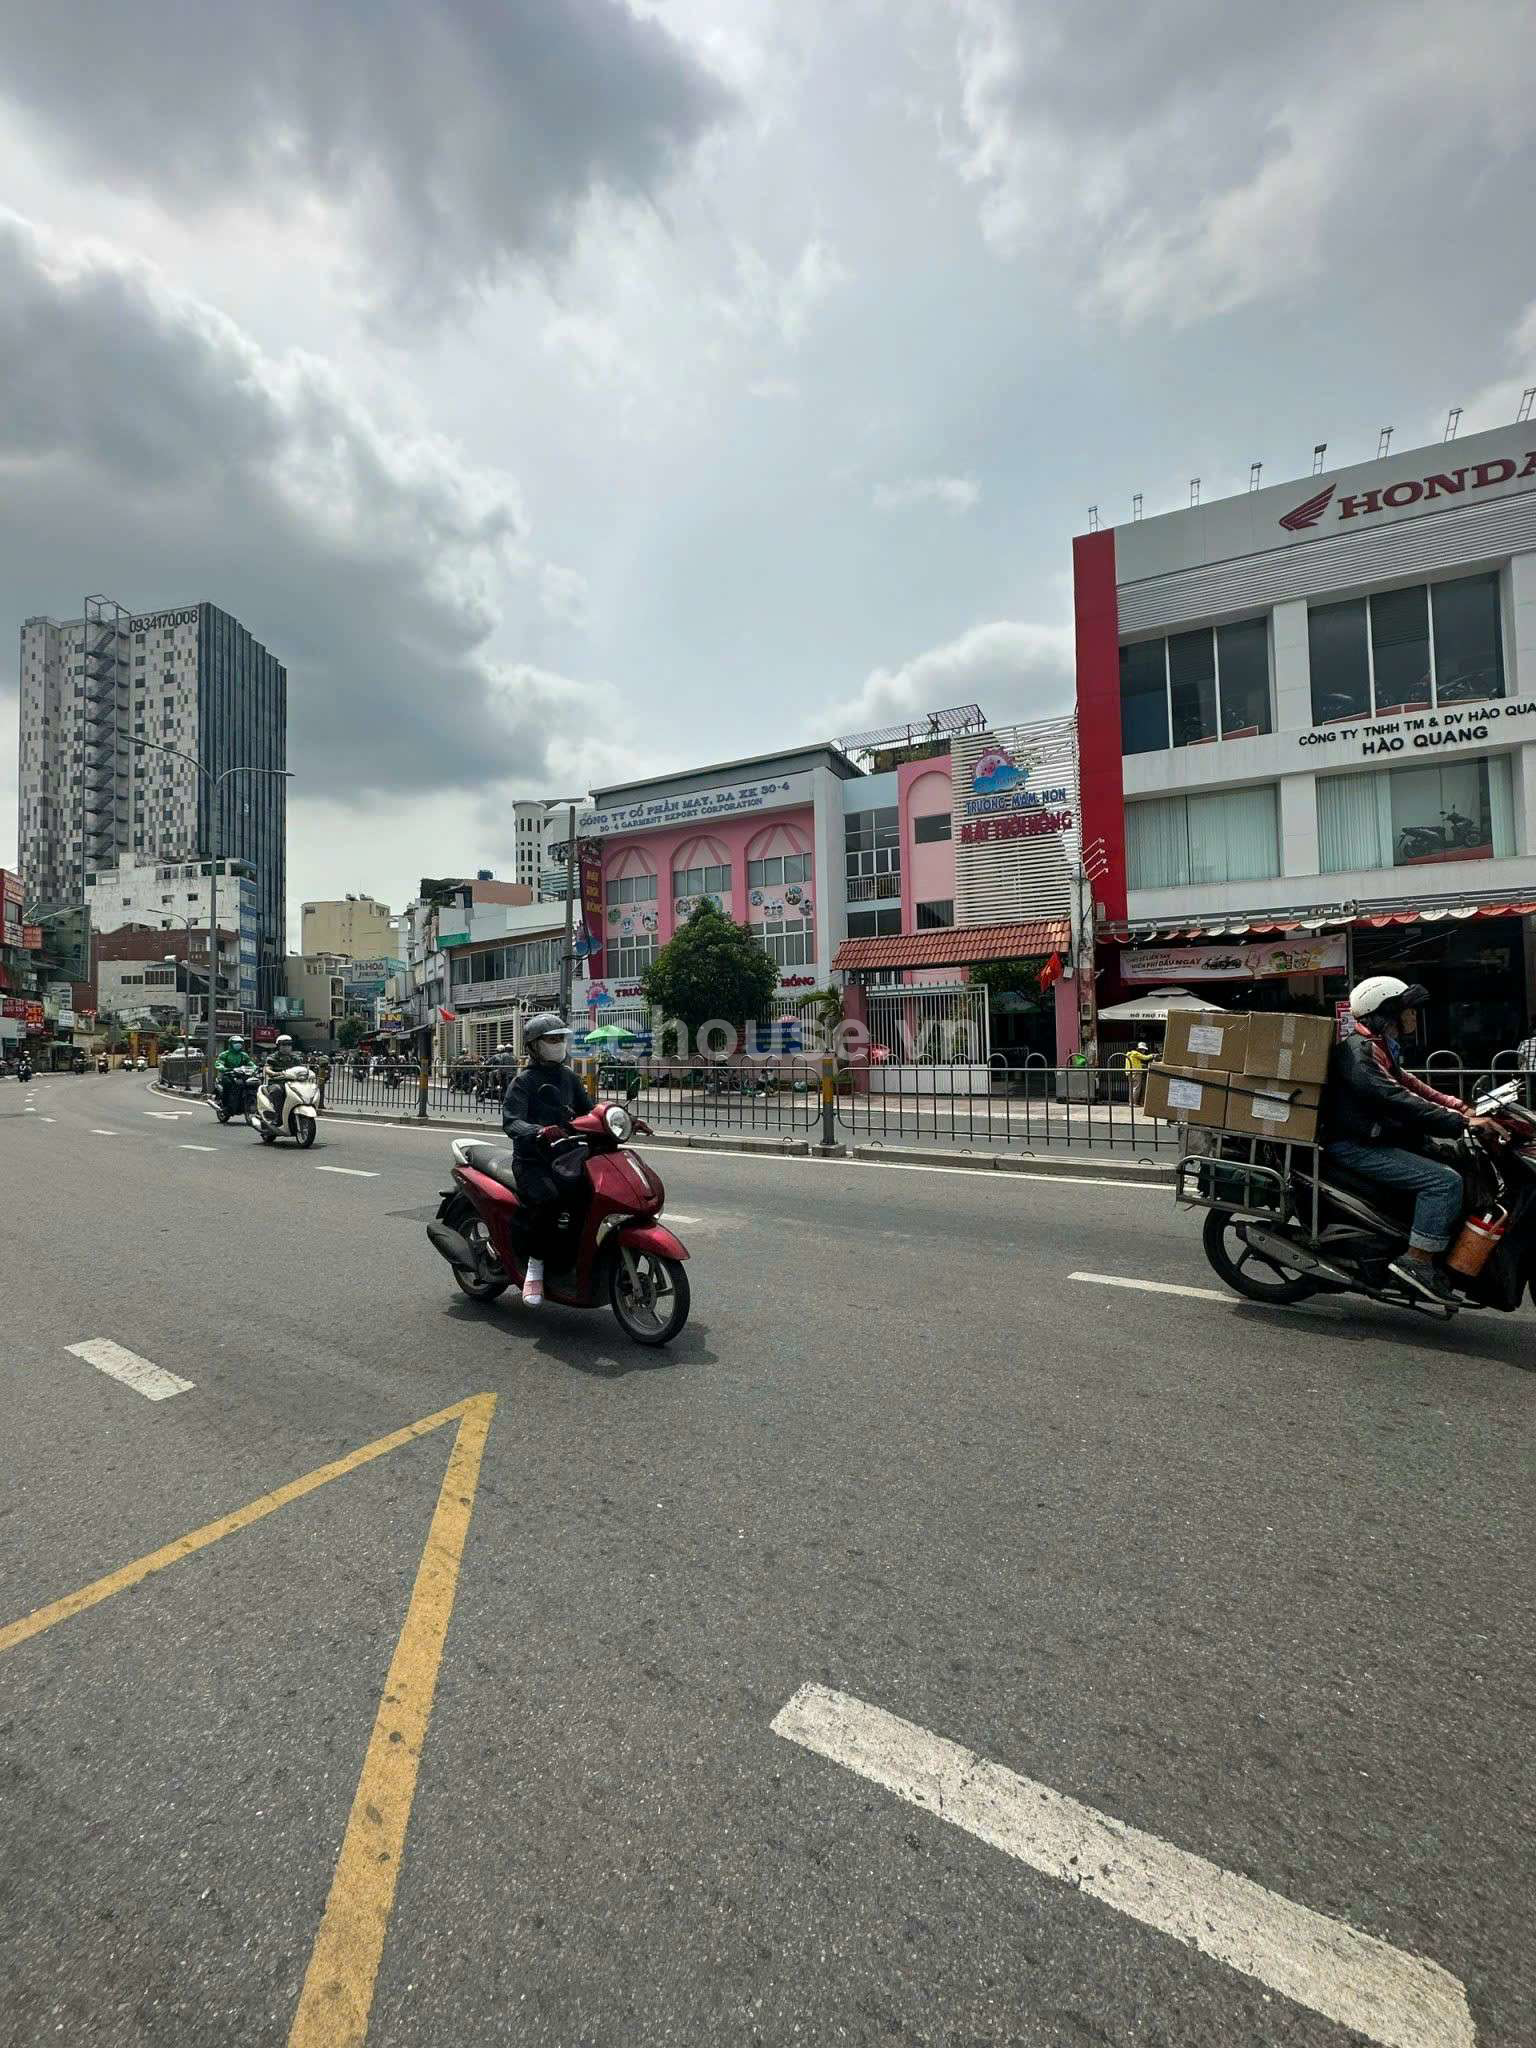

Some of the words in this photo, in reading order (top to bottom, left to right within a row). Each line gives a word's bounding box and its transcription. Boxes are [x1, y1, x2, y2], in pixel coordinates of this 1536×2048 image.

[130, 609, 198, 633] 0934170008
[1299, 731, 1336, 746] CÔNG
[1340, 729, 1358, 740] TY
[1363, 722, 1400, 737] TNHH
[1404, 719, 1424, 731] TM
[1429, 717, 1439, 728] &
[1444, 713, 1463, 726] DV
[1468, 706, 1500, 722] HÀO
[1362, 737, 1405, 756] HÀO
[1413, 726, 1489, 749] QUANG
[612, 812, 626, 821] TY
[716, 792, 735, 803] DA
[1042, 788, 1066, 803] NON
[621, 815, 662, 828] GARMENT
[701, 798, 763, 814] CORPORATION
